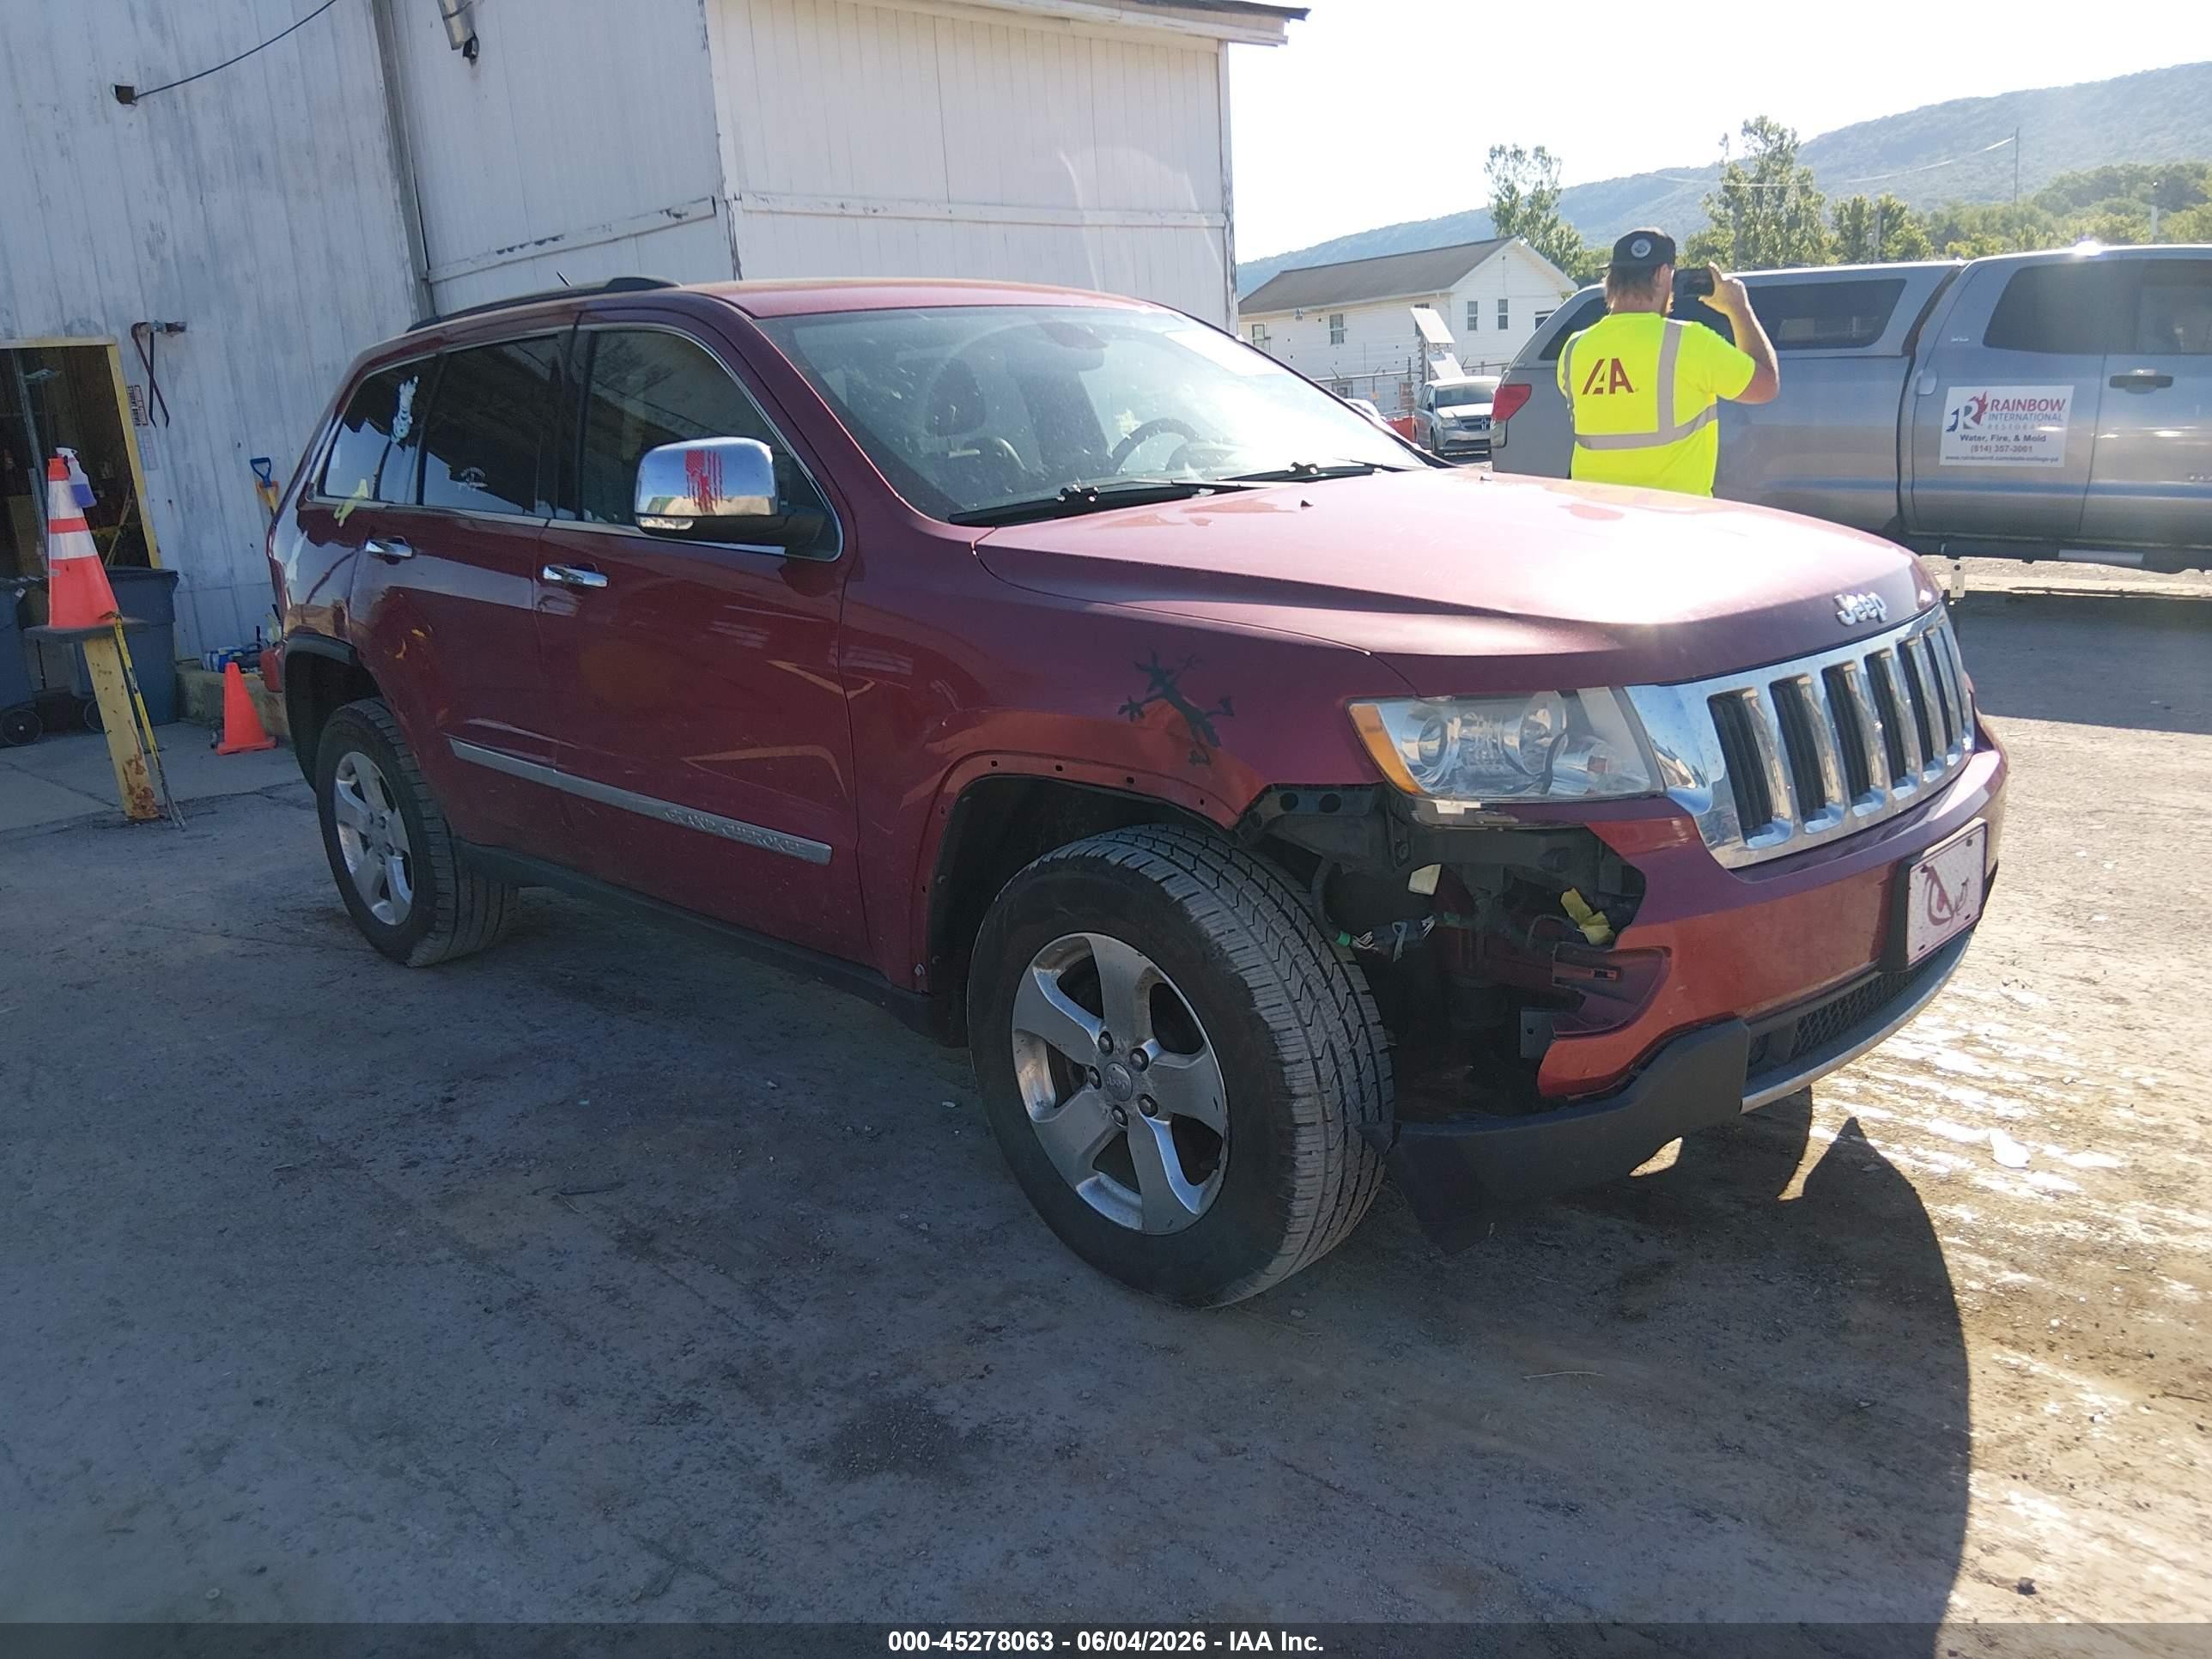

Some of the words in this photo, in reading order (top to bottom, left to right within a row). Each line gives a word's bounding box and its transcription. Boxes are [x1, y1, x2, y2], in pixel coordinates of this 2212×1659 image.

[1990, 398, 2066, 412] RAINBOW
[1988, 413, 2063, 422] INTERNATIONAL
[1960, 434, 1987, 443] Water,
[1990, 434, 2011, 443] Fire,
[2024, 434, 2047, 442] Mold
[1834, 592, 1887, 627] Jeep
[721, 823, 805, 853] CHEROKEE
